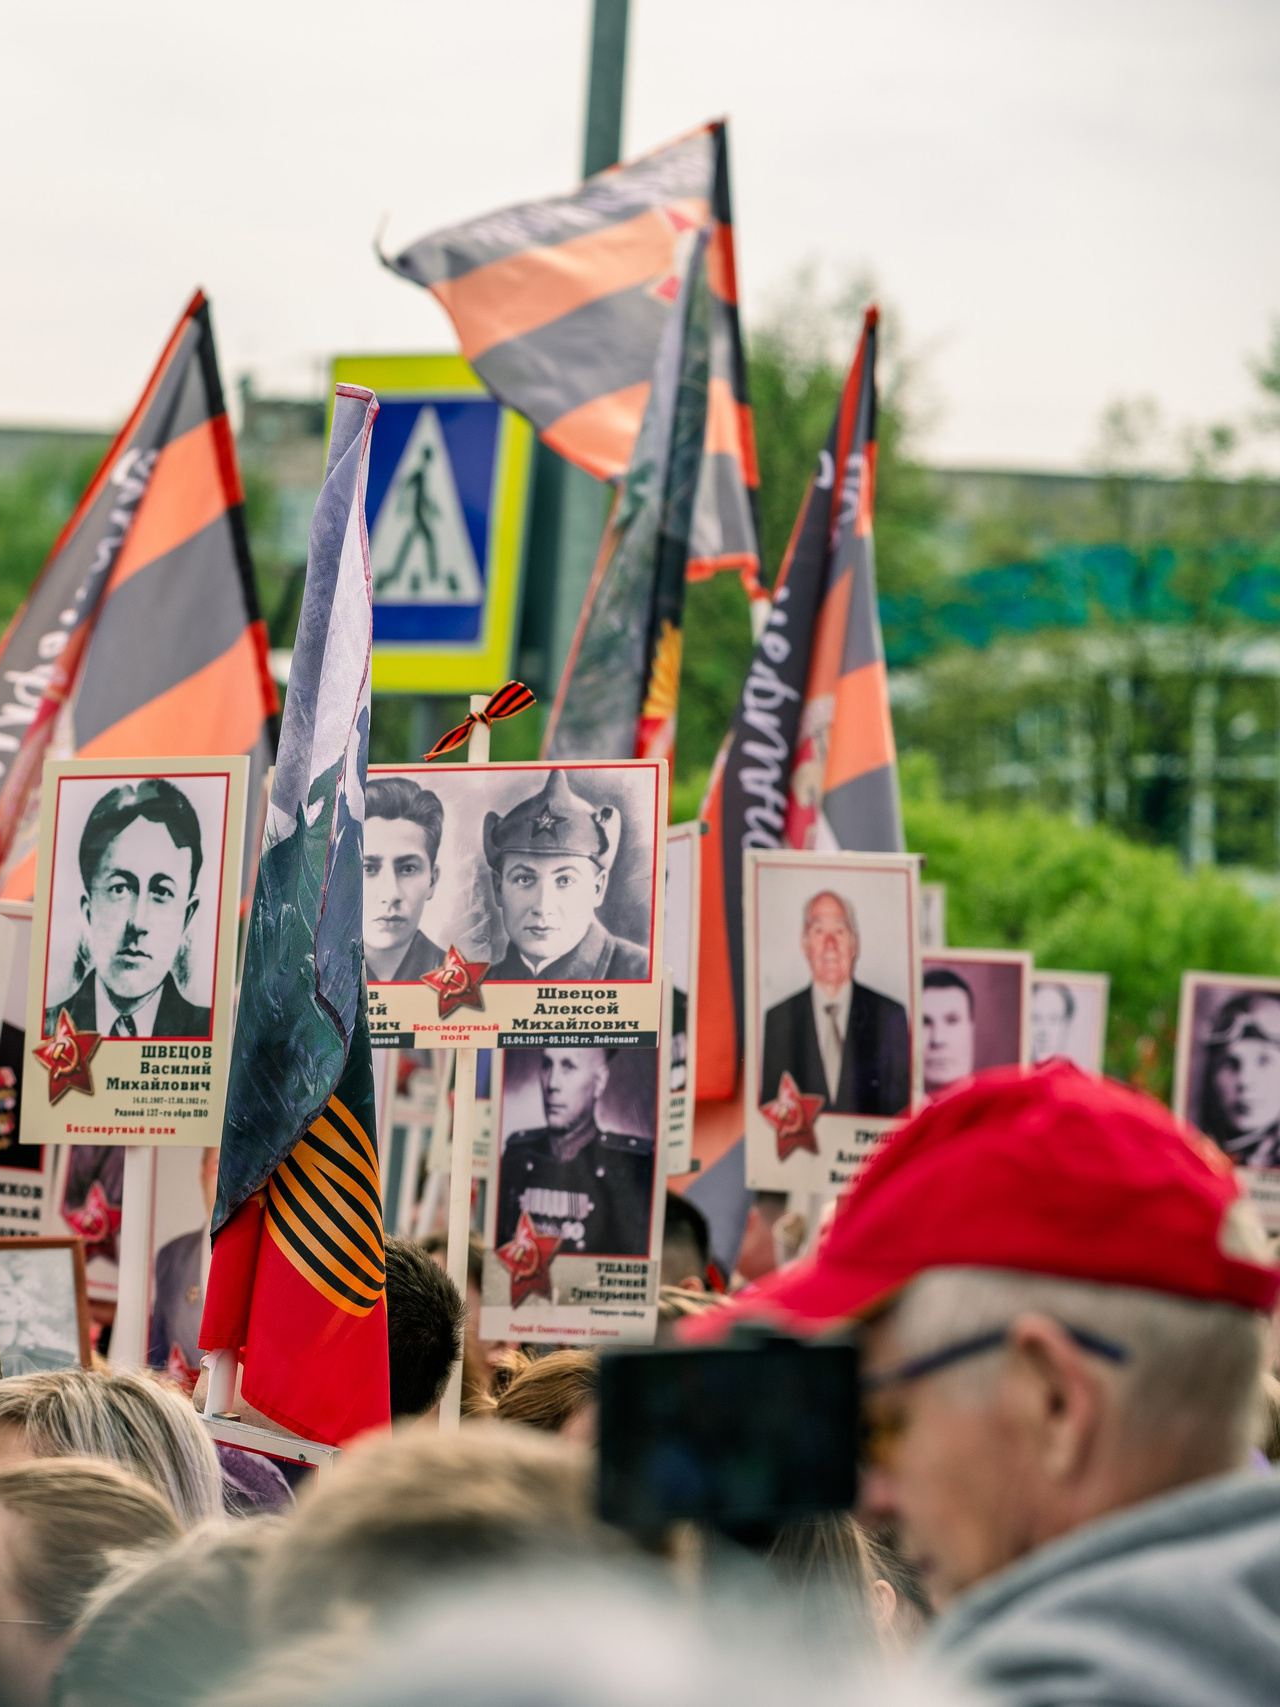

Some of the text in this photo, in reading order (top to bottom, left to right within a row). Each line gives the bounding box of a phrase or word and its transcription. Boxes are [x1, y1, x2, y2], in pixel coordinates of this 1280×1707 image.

[537, 987, 617, 1001] Швецов
[534, 1002, 619, 1015] Алексей
[412, 1023, 500, 1033] Бессмертный
[512, 1018, 640, 1031] Михайлович
[440, 1034, 471, 1042] полк
[580, 1037, 593, 1046] гг.
[593, 1034, 640, 1045] Лейтенант
[141, 1045, 213, 1060] ШВЕЦОВ
[140, 1061, 212, 1075] Василий
[106, 1077, 211, 1091] Михайлович
[114, 1108, 145, 1117] Рядовой
[193, 1109, 209, 1118] ПВО
[66, 1124, 177, 1136] Бессмертный полк
